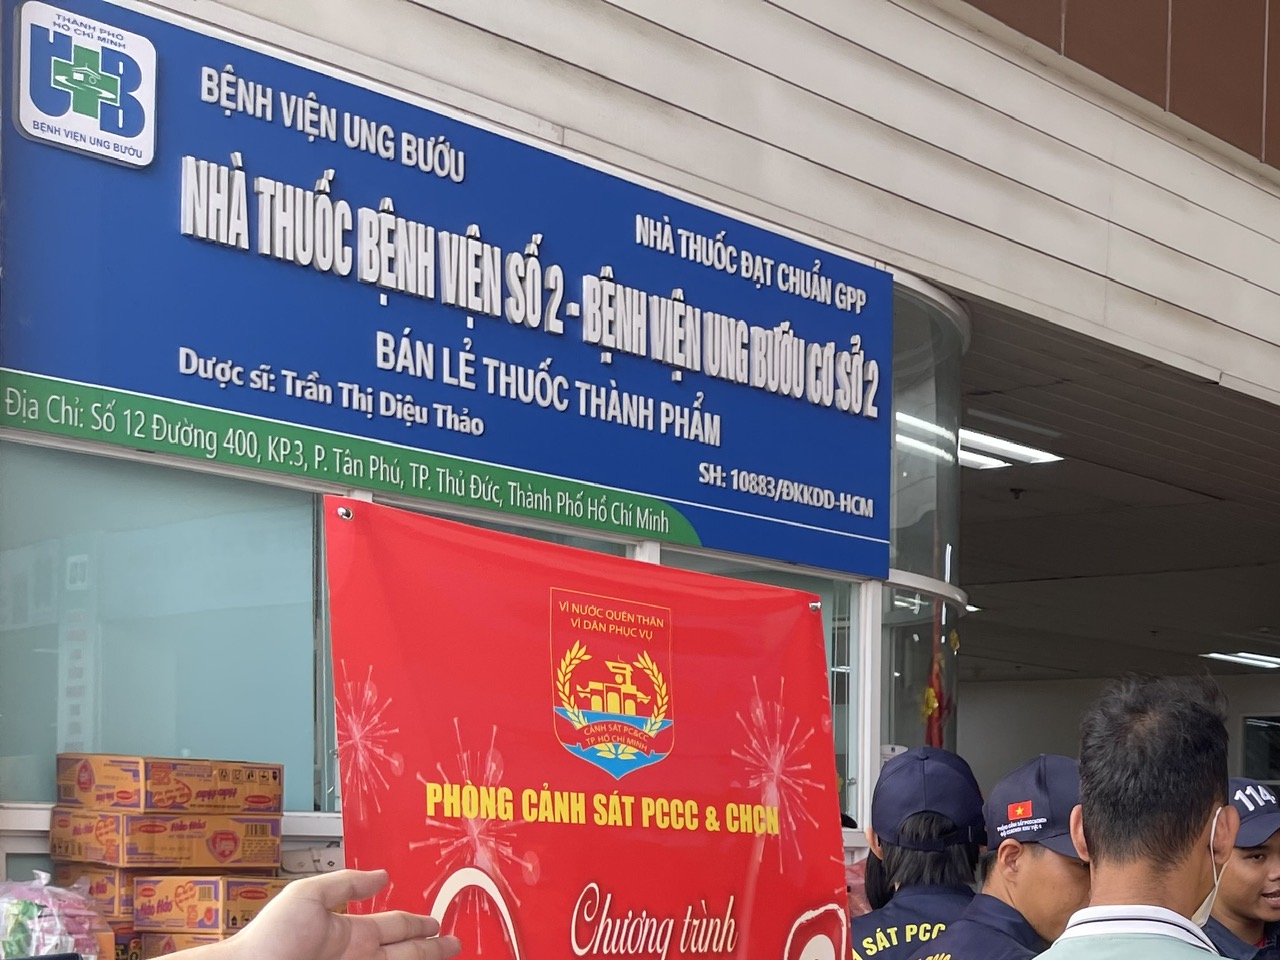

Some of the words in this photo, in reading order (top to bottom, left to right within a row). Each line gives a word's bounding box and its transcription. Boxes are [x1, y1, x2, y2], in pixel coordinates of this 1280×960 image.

[89, 137, 110, 150] UNG
[201, 64, 273, 120] BỆNH
[280, 92, 337, 144] VIỆN
[343, 114, 395, 161] UNG
[402, 133, 465, 183] BƯỚU
[181, 152, 249, 250] NHÀ
[254, 169, 353, 276] THUỐC
[357, 197, 435, 306] BỆNH
[438, 224, 501, 329] VIỆN
[505, 233, 543, 328] SỐ
[544, 264, 564, 334] 2
[566, 301, 580, 317] -
[582, 266, 647, 364] BỆNH
[649, 288, 702, 382] VIỆN
[703, 310, 750, 383] UNG
[750, 320, 805, 398] BƯỚU
[805, 339, 835, 407] CƠ
[835, 334, 864, 415] SỞ
[863, 359, 879, 419] 2
[635, 214, 675, 255] NHÀ
[677, 231, 737, 274] THUỐC
[741, 250, 775, 290] ĐẠT
[776, 259, 832, 305] CHUẨN
[834, 282, 866, 314] GPP
[179, 346, 245, 391] Dược
[249, 360, 276, 394] sĩ:
[280, 370, 333, 405] Trần
[337, 380, 375, 419] Thị
[379, 390, 430, 425] Diệu
[434, 398, 485, 437] Thảo
[376, 328, 435, 378] BÁN
[442, 337, 476, 391] LẺ
[483, 358, 569, 413] THUỐC
[575, 378, 656, 432] THÀNH
[660, 391, 721, 448] PHẨM
[4, 387, 40, 422] Địa
[46, 393, 85, 430] Chỉ:
[90, 398, 117, 434] Số
[122, 409, 147, 438] 12
[151, 411, 218, 460] Đường
[222, 425, 260, 463] 400,
[266, 436, 309, 471] KP.3,
[313, 443, 330, 472] P.
[332, 446, 364, 478] Tân
[367, 451, 404, 487] Phú,
[409, 461, 432, 491] TP.
[435, 464, 467, 498] Thủ
[469, 468, 503, 508] Đức,
[507, 479, 552, 514] Thành
[556, 487, 585, 520] Phố
[587, 495, 608, 523] Hồ
[610, 501, 633, 527] Chí
[636, 508, 669, 534] Minh
[699, 462, 727, 489] SH:
[558, 600, 570, 613] VÌ
[571, 603, 604, 619] NƯỚC
[605, 609, 635, 624] QUÊN
[636, 614, 664, 628] THÂN
[571, 618, 582, 629] VÌ
[583, 620, 607, 633] DÂN
[608, 626, 637, 639] PHỤC
[639, 630, 654, 641] VỤ
[626, 736, 649, 752] MINH
[426, 782, 514, 821] PHÒNG
[521, 787, 586, 825] CẢNH
[594, 793, 634, 827] SÁT
[641, 798, 699, 831] PCCC
[705, 806, 721, 832] &
[726, 806, 780, 836] CHCN
[1233, 784, 1277, 812] 114
[679, 895, 738, 954] trình
[862, 927, 899, 956] SÁT
